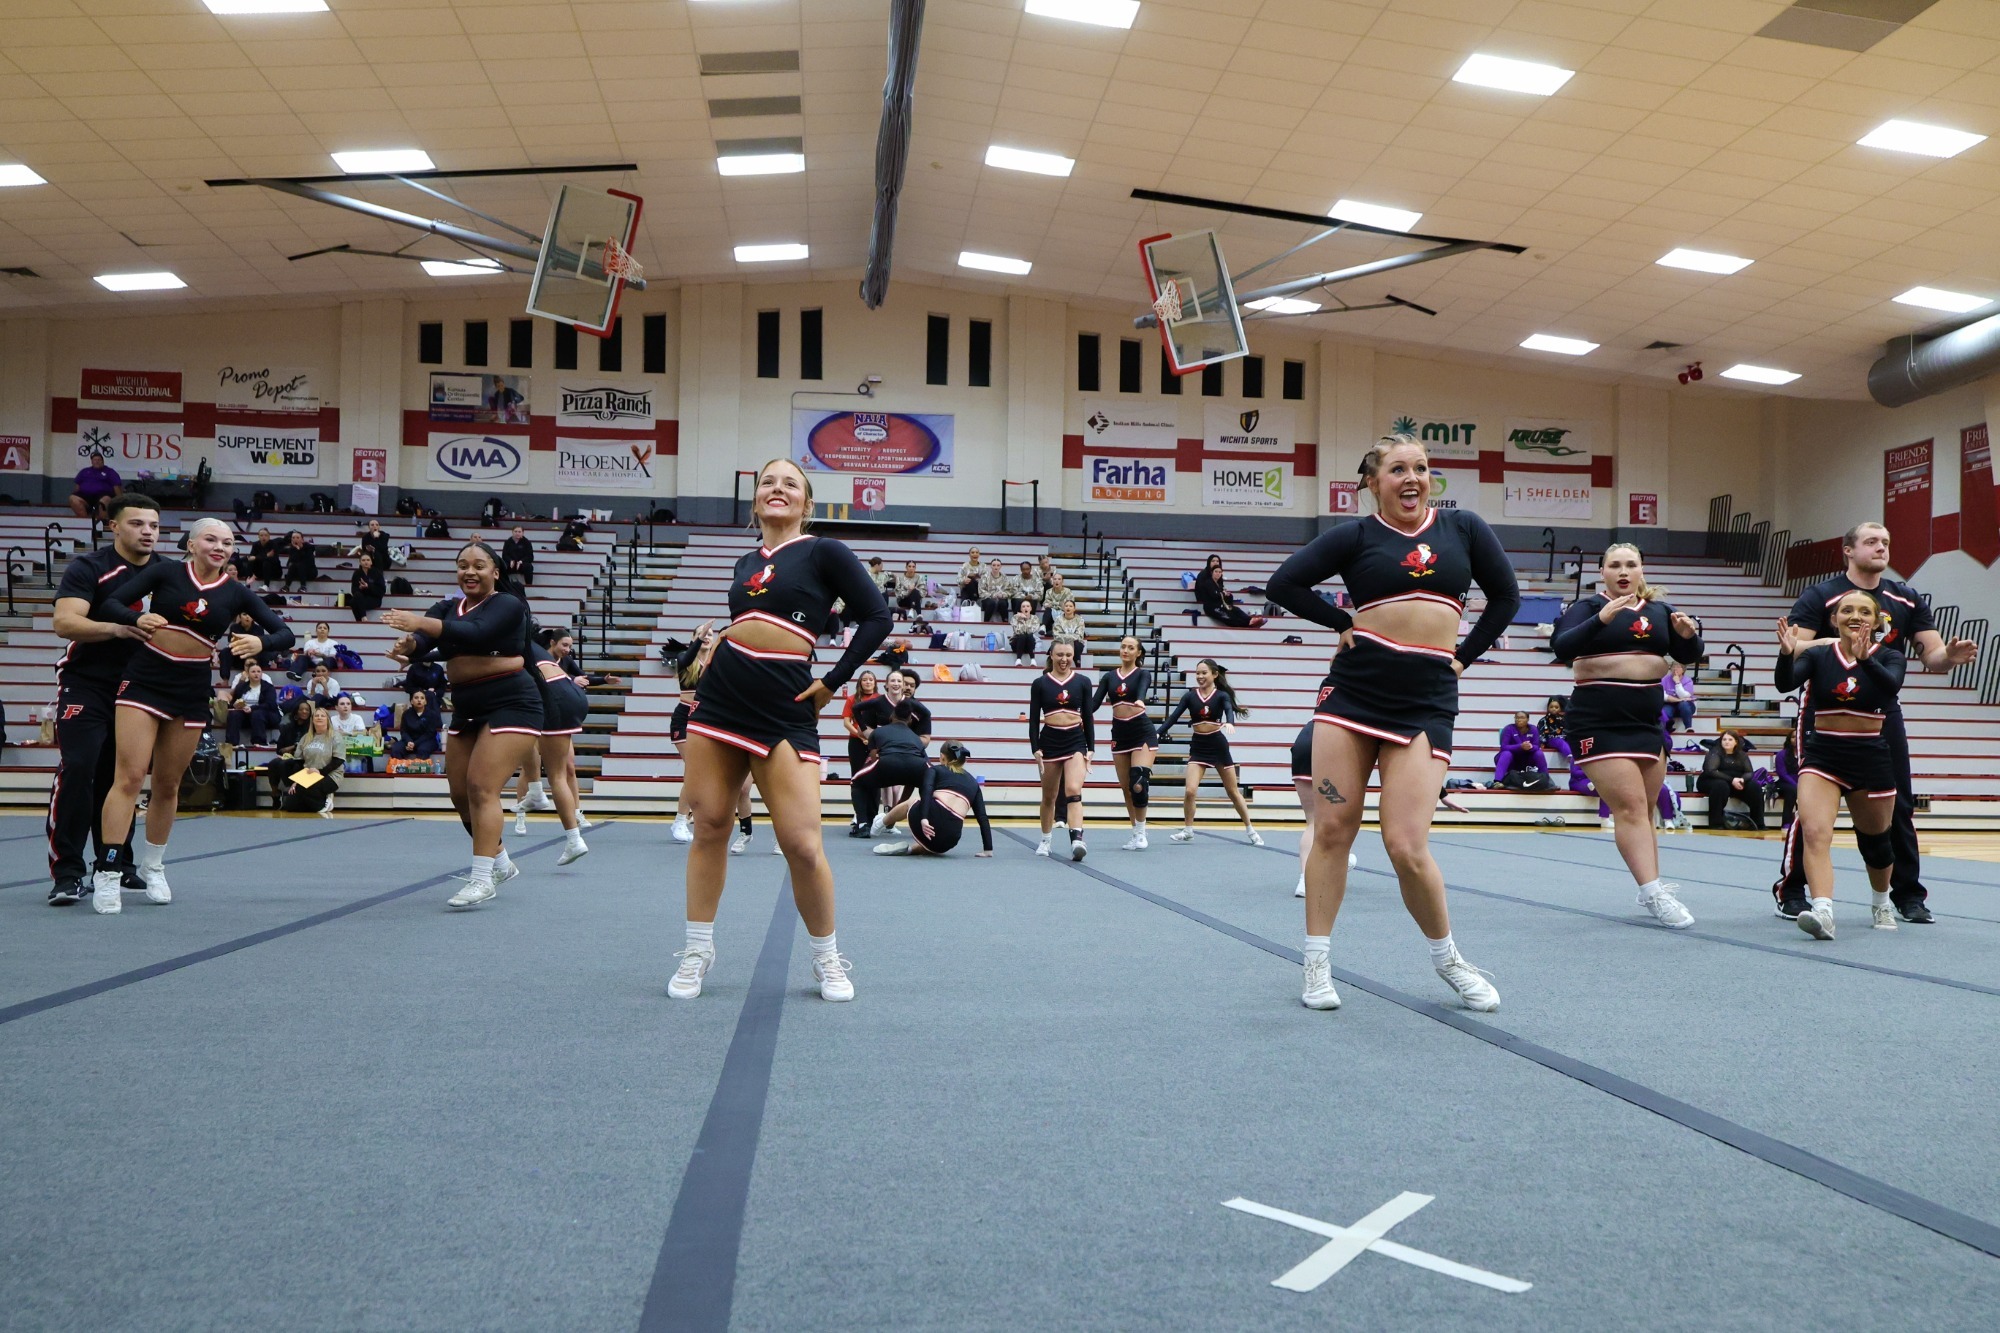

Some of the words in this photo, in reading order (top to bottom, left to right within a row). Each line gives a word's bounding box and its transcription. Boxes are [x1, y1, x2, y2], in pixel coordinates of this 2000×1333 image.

[115, 376, 148, 386] WICHITA
[217, 366, 270, 387] Promo
[91, 384, 134, 396] BUSINESS
[135, 386, 173, 398] JOURNAL
[252, 374, 306, 404] Depot
[562, 393, 603, 412] Pizza
[605, 391, 651, 415] Ranch
[854, 413, 888, 428] NAIA
[121, 432, 182, 461] UBS
[217, 435, 316, 451] SUPPLEMENT
[1219, 435, 1249, 445] WICHITA
[1251, 436, 1279, 446] SPORTS
[3, 446, 21, 466] A
[354, 450, 385, 458] SECTION
[451, 447, 507, 469] IMA
[558, 444, 652, 478] PHOENIX
[877, 455, 924, 463] SPORTSMANSHIP
[1889, 445, 1928, 464] FRIENDS
[361, 459, 377, 478] B
[1093, 458, 1166, 486] Farha
[854, 478, 885, 486] SECTION
[1330, 482, 1358, 490] SECTION
[862, 487, 877, 506] C
[1095, 488, 1163, 500] ROOFING
[1337, 491, 1352, 509] D
[1526, 487, 1590, 499] SHELDEN
[1638, 503, 1650, 520] E
[61, 704, 84, 719] F
[1580, 736, 1594, 756] F
